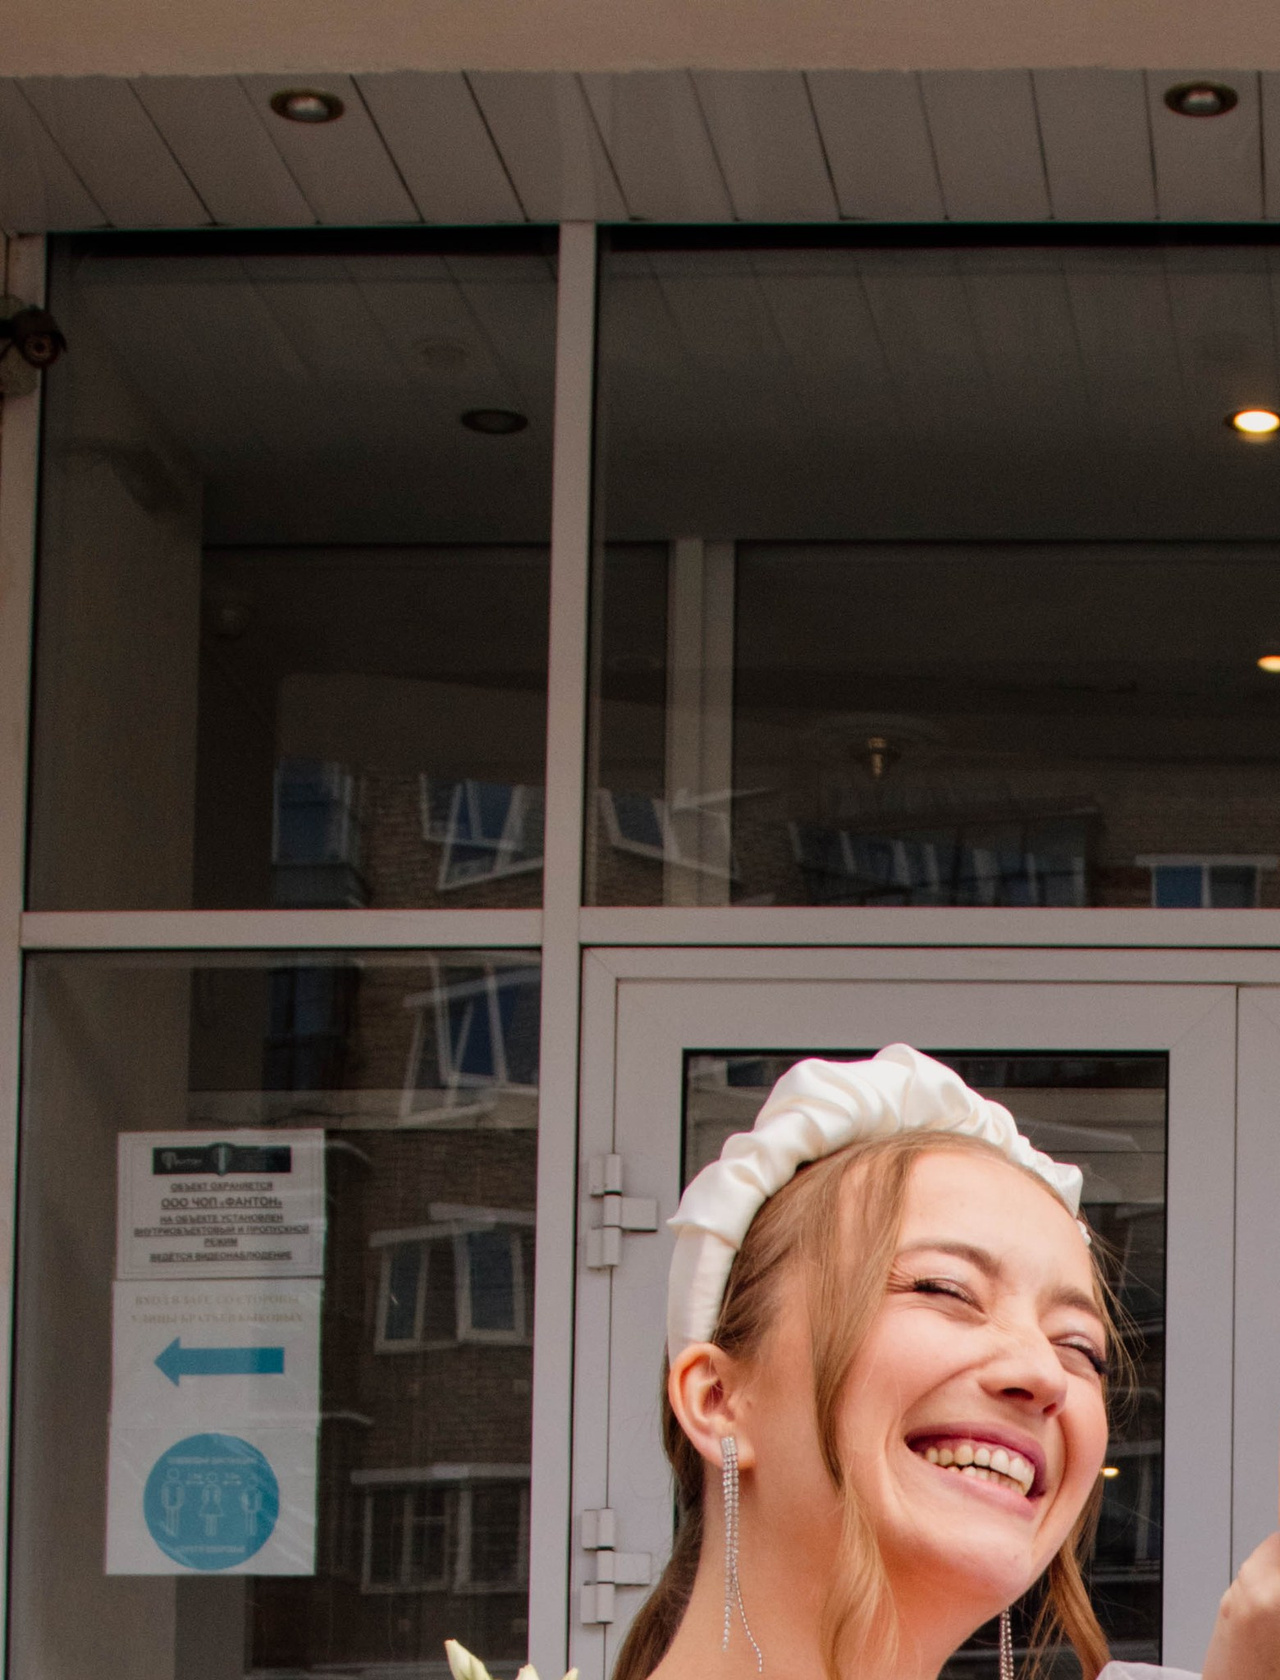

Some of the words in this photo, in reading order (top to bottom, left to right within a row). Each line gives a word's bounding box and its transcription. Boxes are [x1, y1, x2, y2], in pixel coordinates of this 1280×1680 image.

[170, 1182, 207, 1192] ОБЪЕКТ
[210, 1181, 273, 1191] ОХРАНЯЕТСЯ
[161, 1197, 189, 1208] ООО
[192, 1197, 218, 1208] ЧОП
[221, 1196, 283, 1208] «ФАНТОН»
[160, 1215, 173, 1224] НА
[175, 1214, 218, 1224] ОБЪЕКТЕ
[221, 1213, 284, 1223] УСТАНОВЛЕН
[134, 1227, 235, 1237] ВНУТРИОБЪЕКТОВЫЙ
[246, 1224, 309, 1235] ПРОПУСКНОЙ
[204, 1237, 238, 1247] РЕЖИМ
